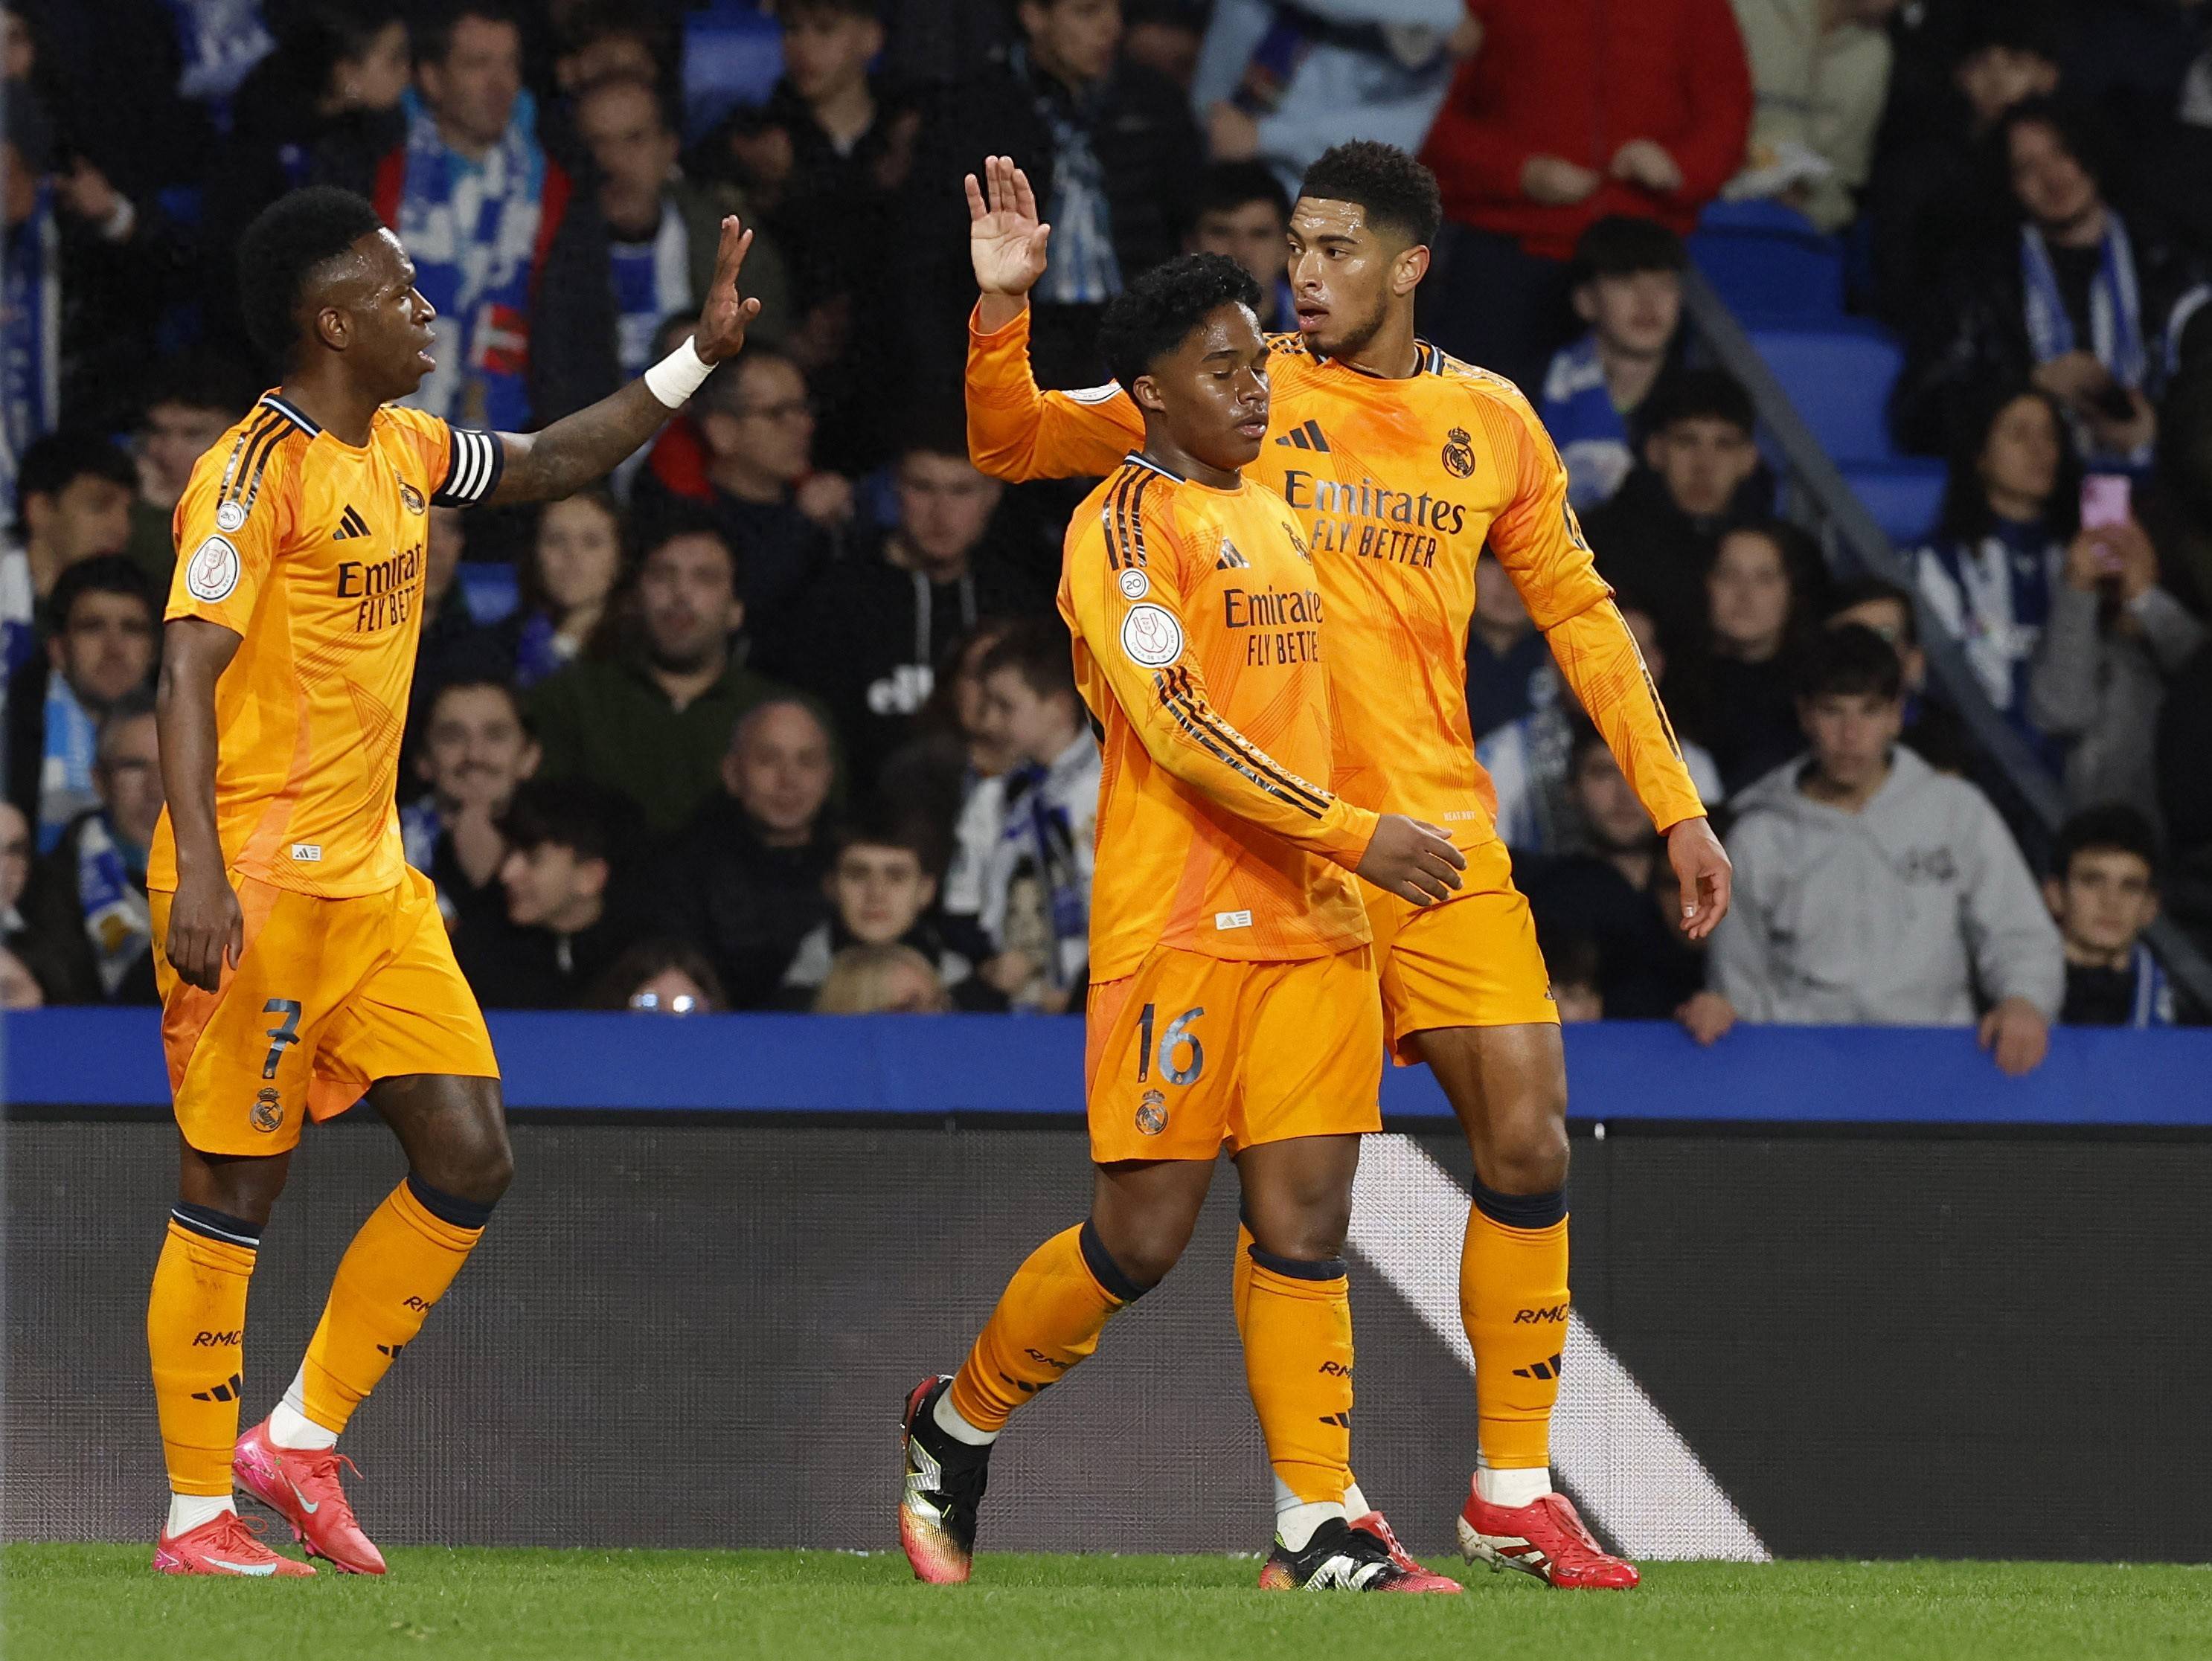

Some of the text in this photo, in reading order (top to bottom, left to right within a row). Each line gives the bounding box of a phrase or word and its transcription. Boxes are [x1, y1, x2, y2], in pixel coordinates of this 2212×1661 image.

[1284, 469, 1466, 535] Emirates
[1311, 518, 1437, 569] FLY BETTER
[1125, 578, 1142, 590] 20
[1223, 584, 1324, 629] Emirate
[356, 598, 385, 632] FLY
[1247, 633, 1271, 666] FLY
[262, 998, 302, 1079] 7
[1136, 1003, 1205, 1085] 16
